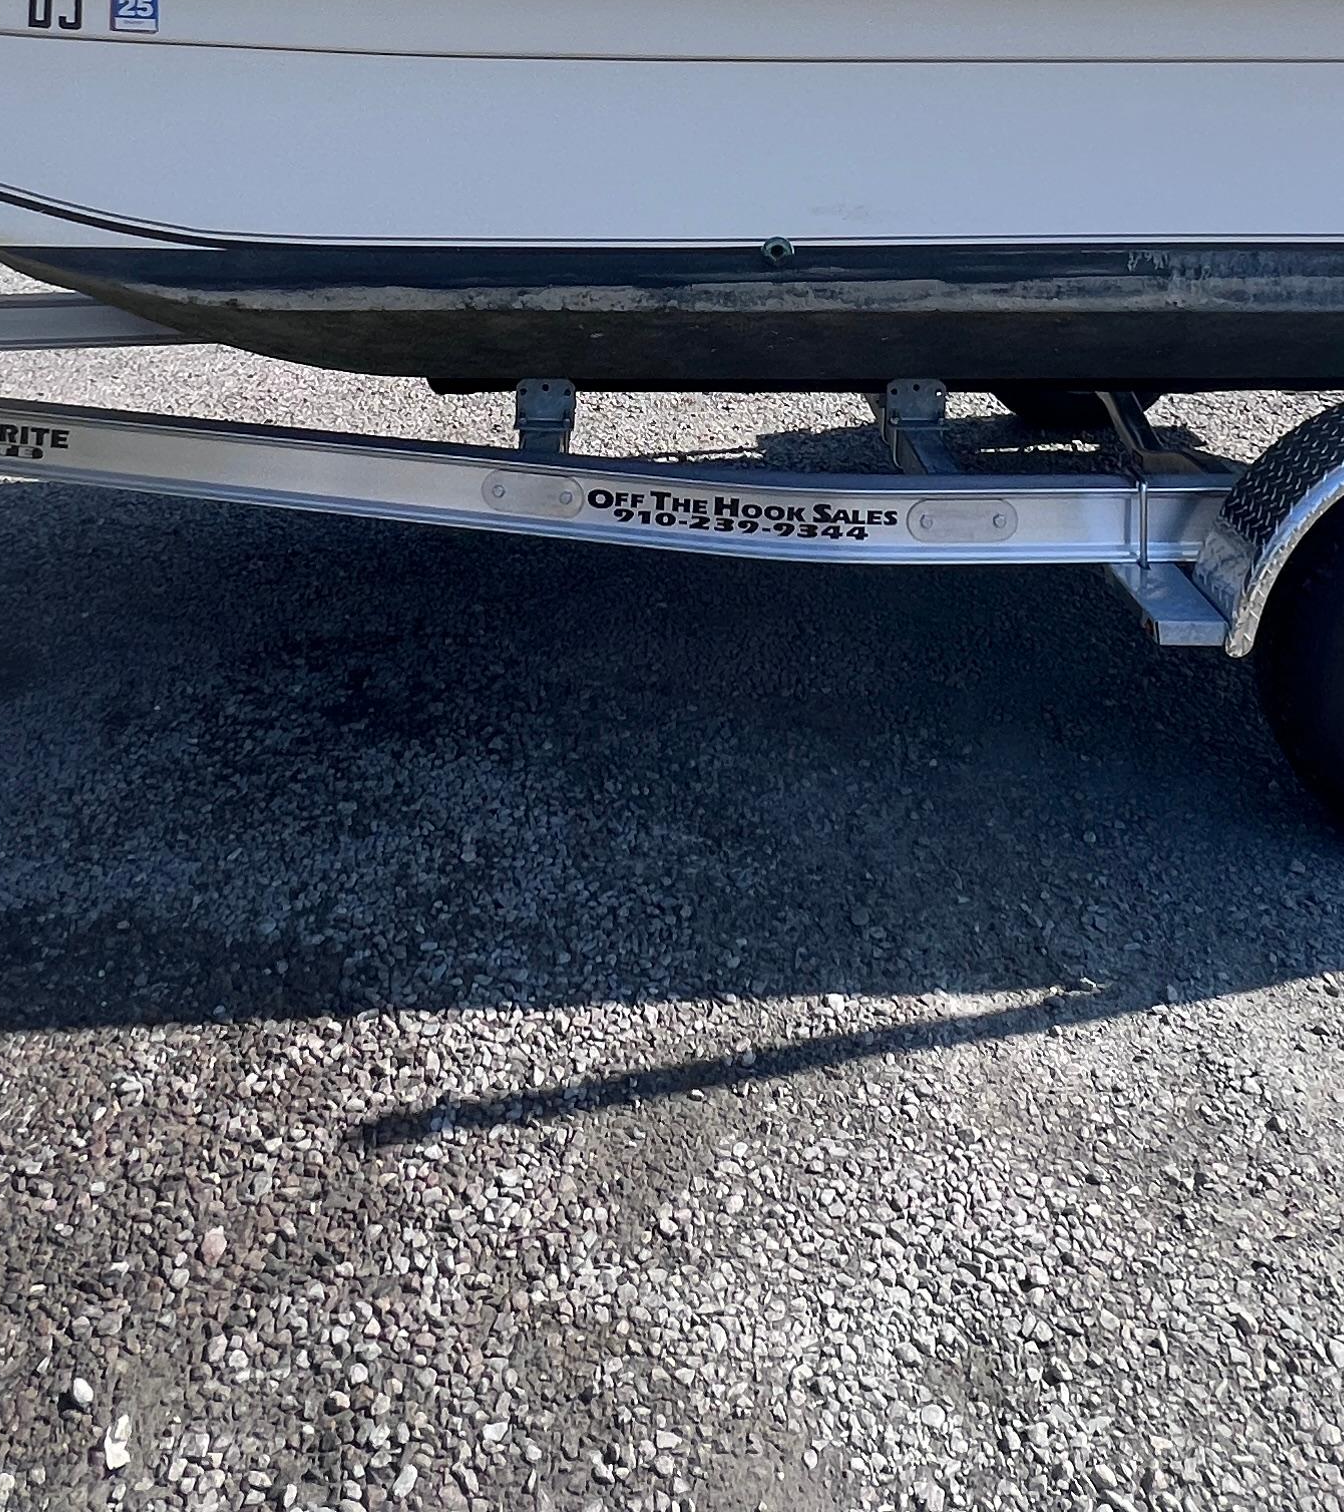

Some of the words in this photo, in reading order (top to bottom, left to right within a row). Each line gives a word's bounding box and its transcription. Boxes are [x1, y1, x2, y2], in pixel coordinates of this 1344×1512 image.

[0, 423, 70, 449] RITE
[587, 489, 645, 509] OFF
[650, 490, 708, 514] THE
[714, 496, 806, 522] HOOK
[813, 504, 898, 526] SALES
[613, 508, 869, 540] 910-239-9344
